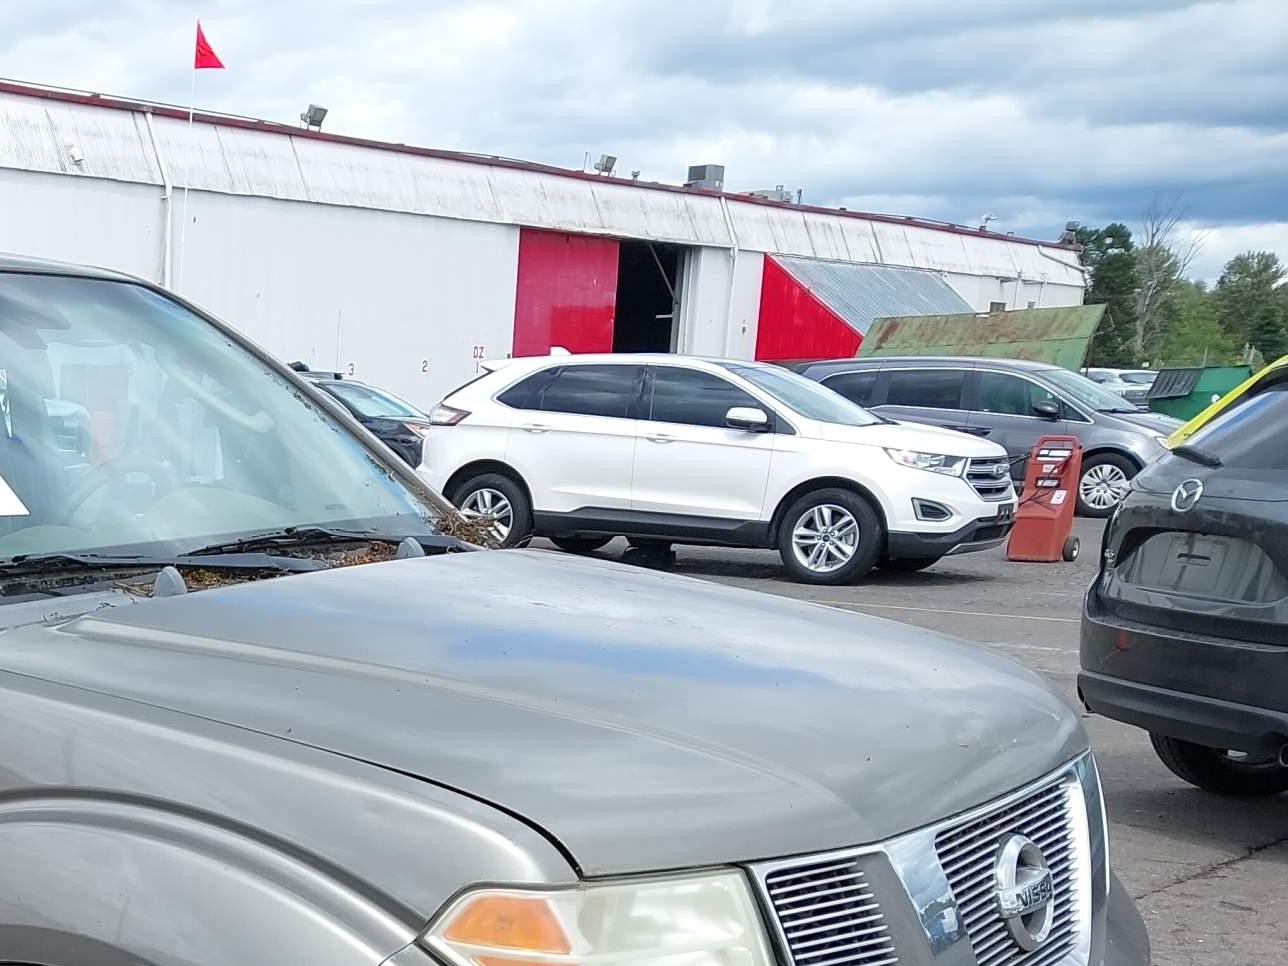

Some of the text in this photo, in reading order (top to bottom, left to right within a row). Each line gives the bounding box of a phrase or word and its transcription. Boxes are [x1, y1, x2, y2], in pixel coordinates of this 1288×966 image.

[348, 363, 355, 376] 3
[422, 360, 428, 373] 2
[1015, 882, 1053, 908] NISSA
